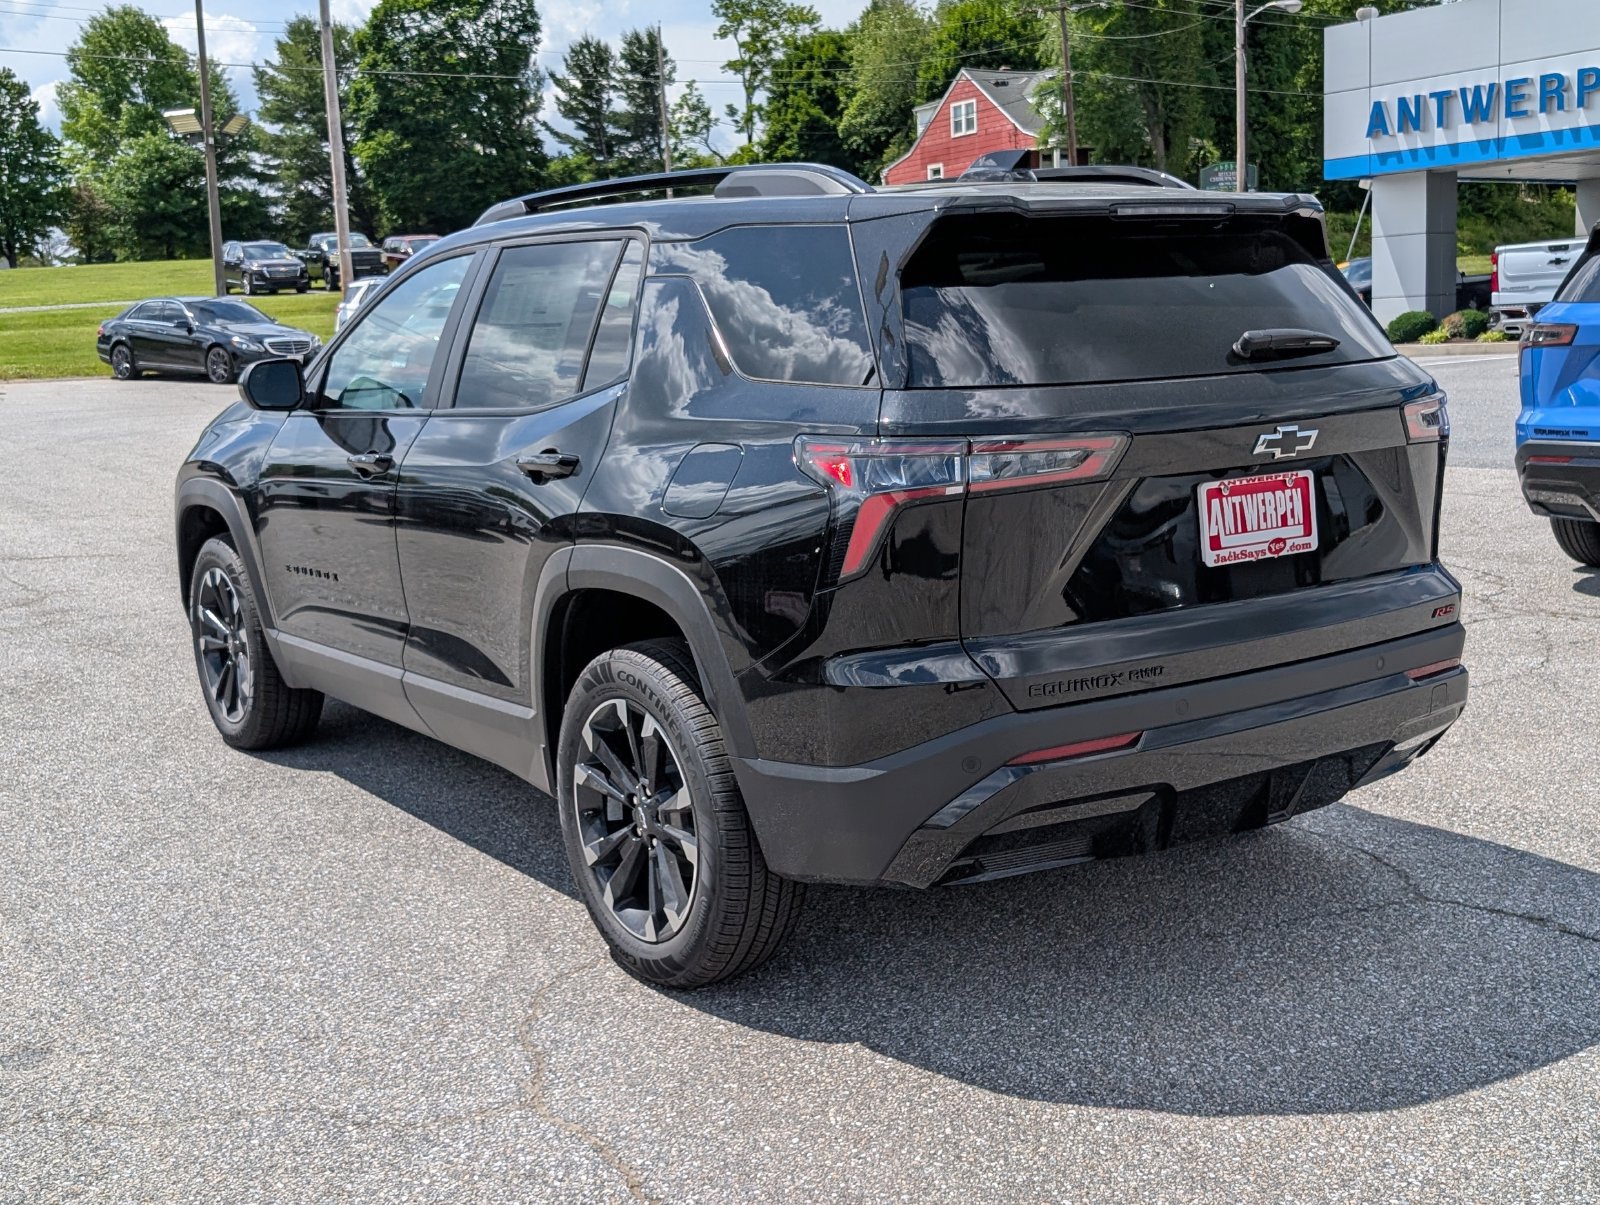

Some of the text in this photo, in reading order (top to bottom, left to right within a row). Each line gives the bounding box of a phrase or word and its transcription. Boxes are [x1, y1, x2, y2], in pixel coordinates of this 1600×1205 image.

[1365, 66, 1600, 138] ANTWERP
[1218, 472, 1299, 487] ANTWERPEN
[1209, 488, 1304, 541] ANTWERPEN
[1433, 604, 1456, 617] RS
[1028, 672, 1124, 698] EQUINOX
